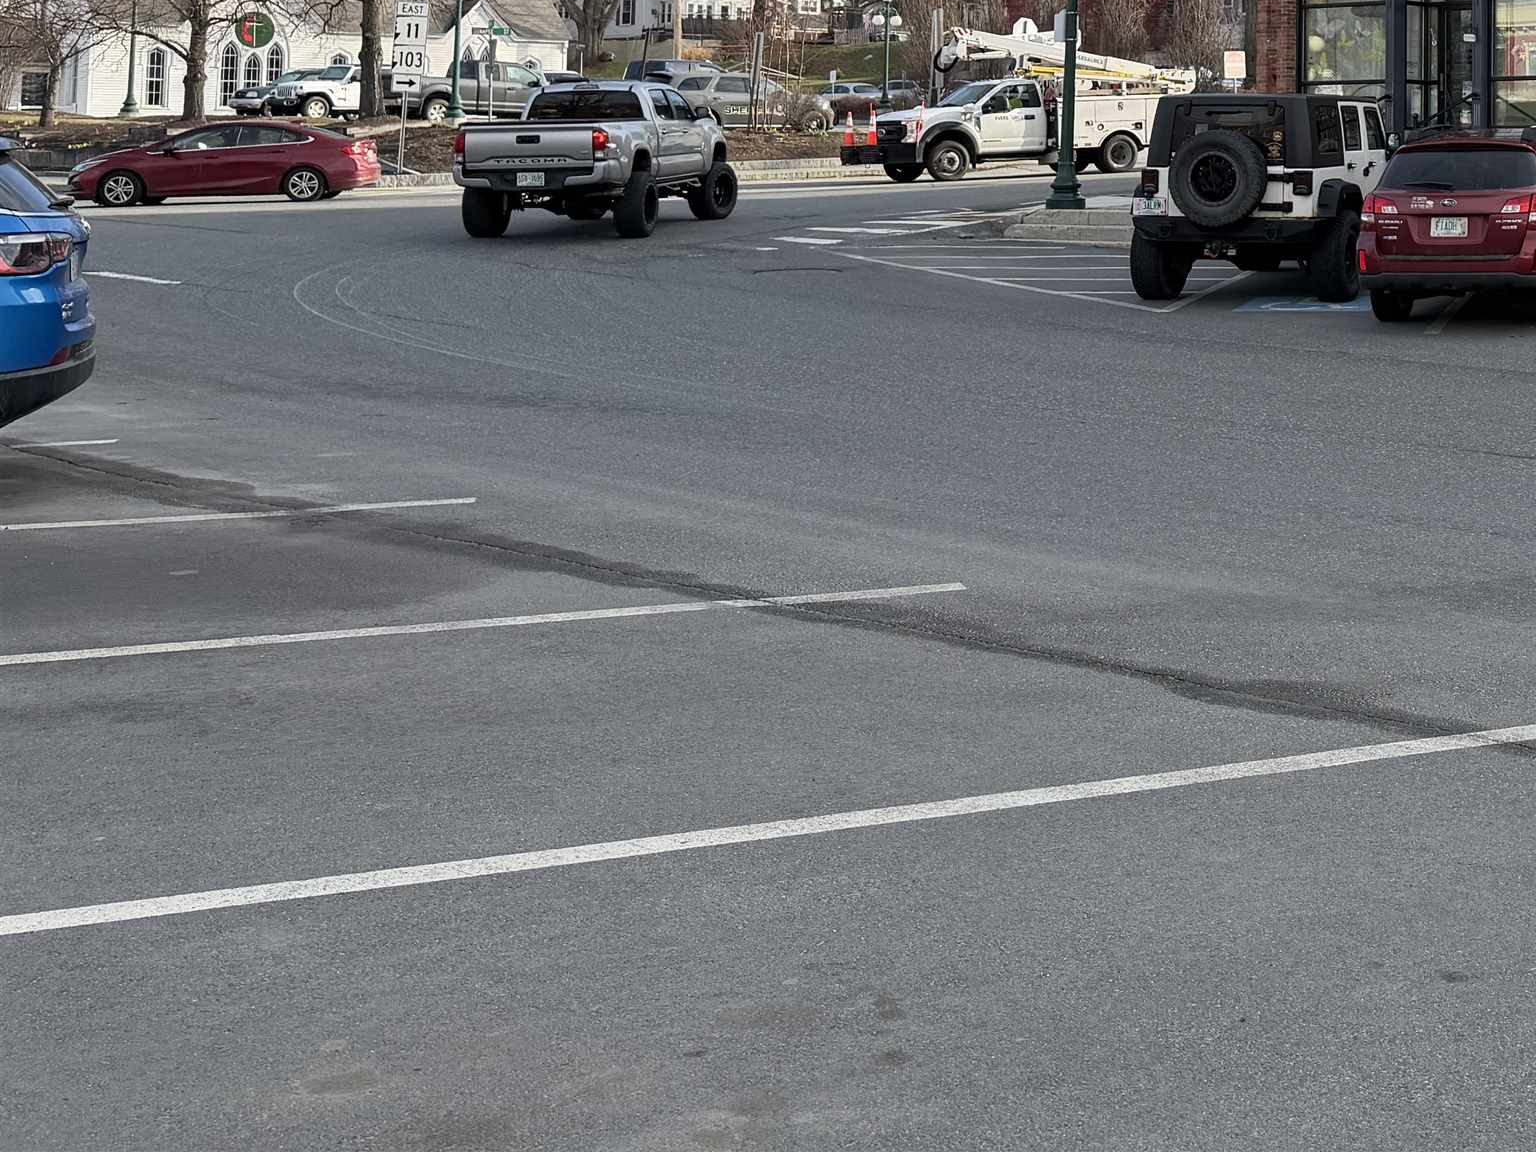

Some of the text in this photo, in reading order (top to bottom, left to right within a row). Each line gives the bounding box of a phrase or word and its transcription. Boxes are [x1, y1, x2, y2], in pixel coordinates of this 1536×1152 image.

[402, 3, 424, 14] EAST
[406, 23, 419, 38] 11
[399, 51, 423, 68] 103
